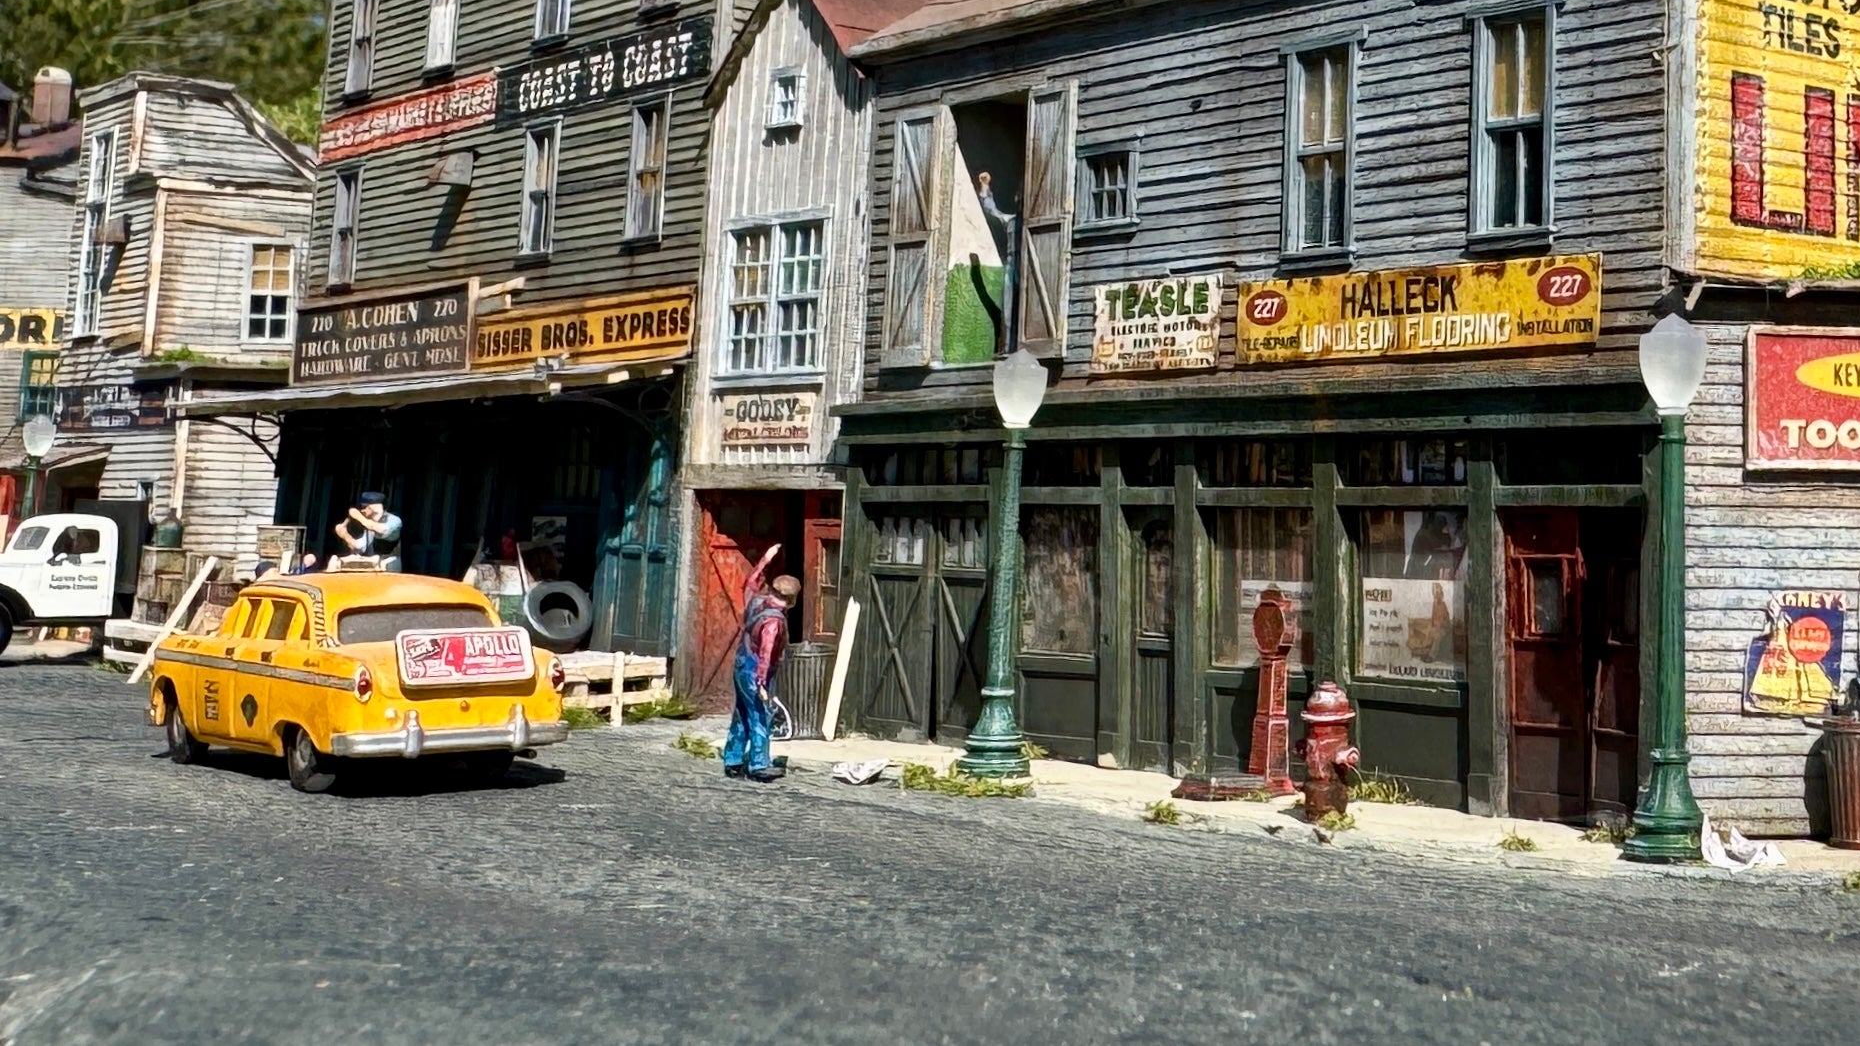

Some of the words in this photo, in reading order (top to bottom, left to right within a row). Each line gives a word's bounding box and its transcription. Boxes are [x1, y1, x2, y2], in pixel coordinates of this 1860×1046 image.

[1760, 0, 1841, 60] TILES
[589, 51, 616, 97] TO
[1105, 282, 1209, 322] TEASLE
[1341, 274, 1459, 320] HALLECK
[1550, 274, 1583, 298] 227
[1253, 297, 1282, 320] 227
[477, 324, 533, 359] SISSER
[541, 318, 595, 351] BROS.
[603, 303, 692, 342] EXPRESS
[1302, 317, 1400, 354] LINOLEUM
[1406, 312, 1512, 350] FLOORING
[465, 634, 521, 656] APOLLO
